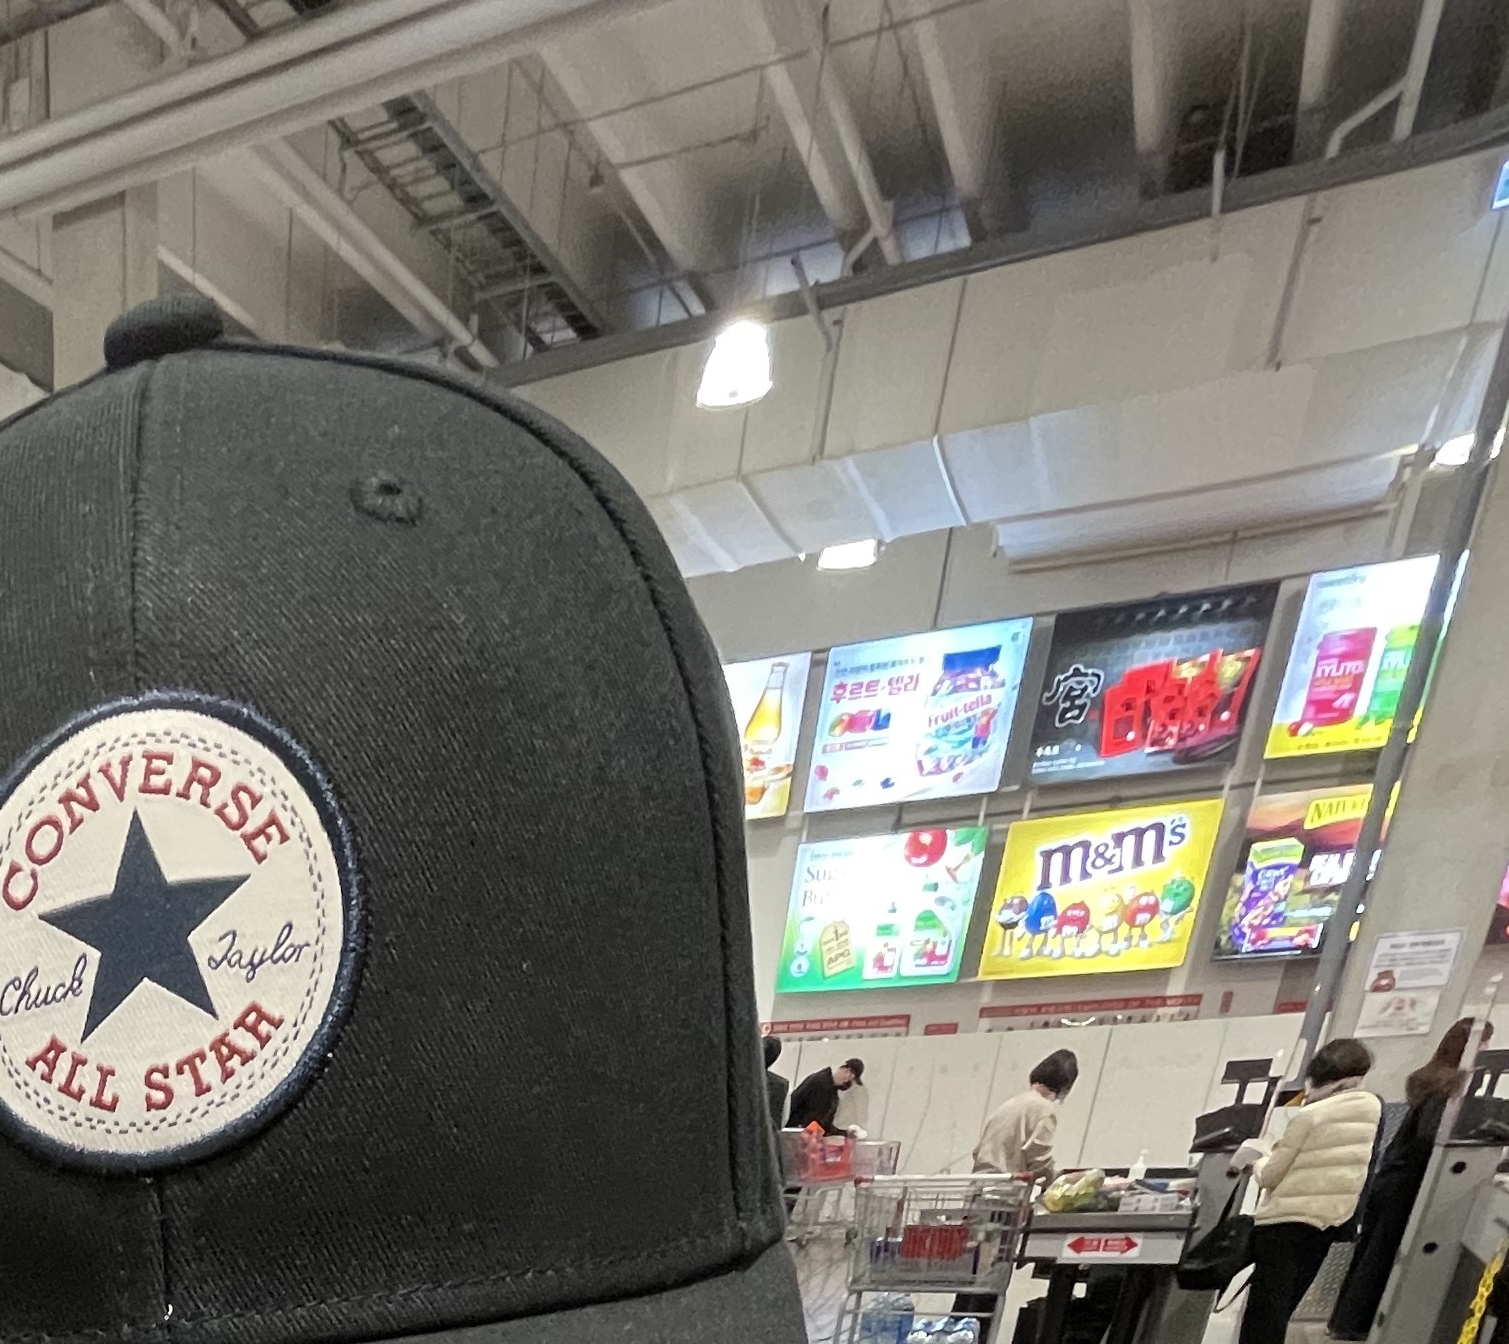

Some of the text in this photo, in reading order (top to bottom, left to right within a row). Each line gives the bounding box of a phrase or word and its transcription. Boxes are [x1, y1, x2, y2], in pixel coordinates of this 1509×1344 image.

[2, 750, 291, 911] CONVERSE
[207, 921, 310, 983] Taylor
[25, 1001, 285, 1112] ALL STAR
